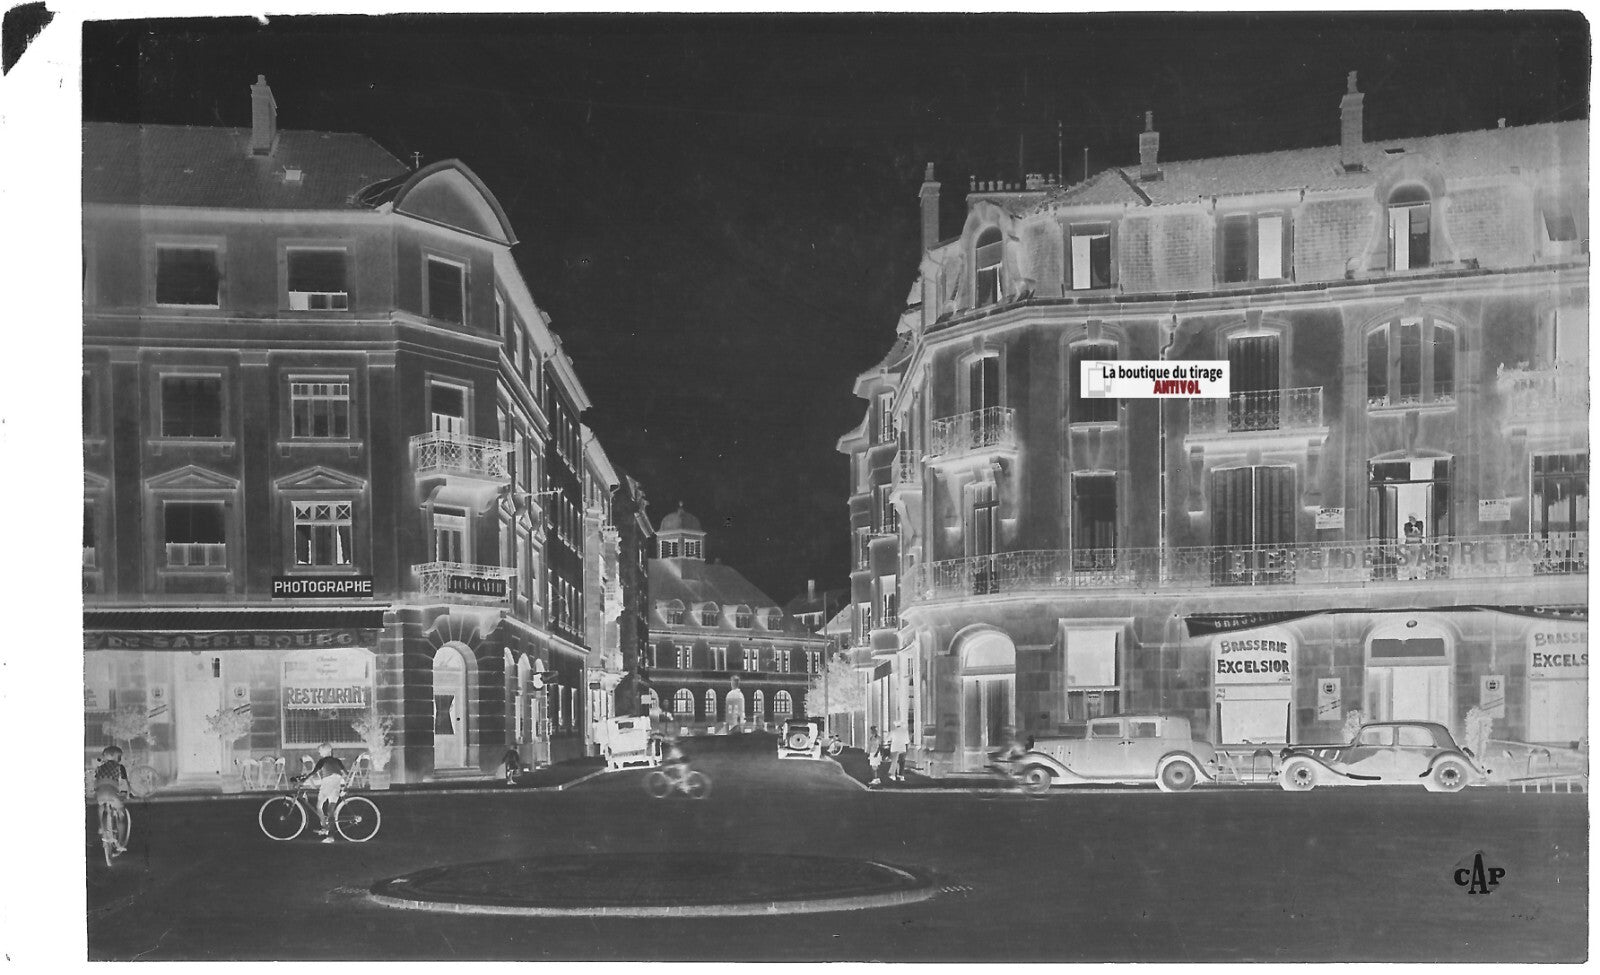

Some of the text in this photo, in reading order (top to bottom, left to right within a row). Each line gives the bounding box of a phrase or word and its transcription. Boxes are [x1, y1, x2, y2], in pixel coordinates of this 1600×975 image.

[274, 580, 372, 593] PHOTOGRAPHE
[152, 632, 352, 648] SARREBOURG
[1220, 640, 1288, 654] BRASSERIE
[1217, 659, 1290, 674] EXCELSIOR
[1532, 653, 1588, 668] EXCELS
[286, 685, 367, 704] RESTAURANT
